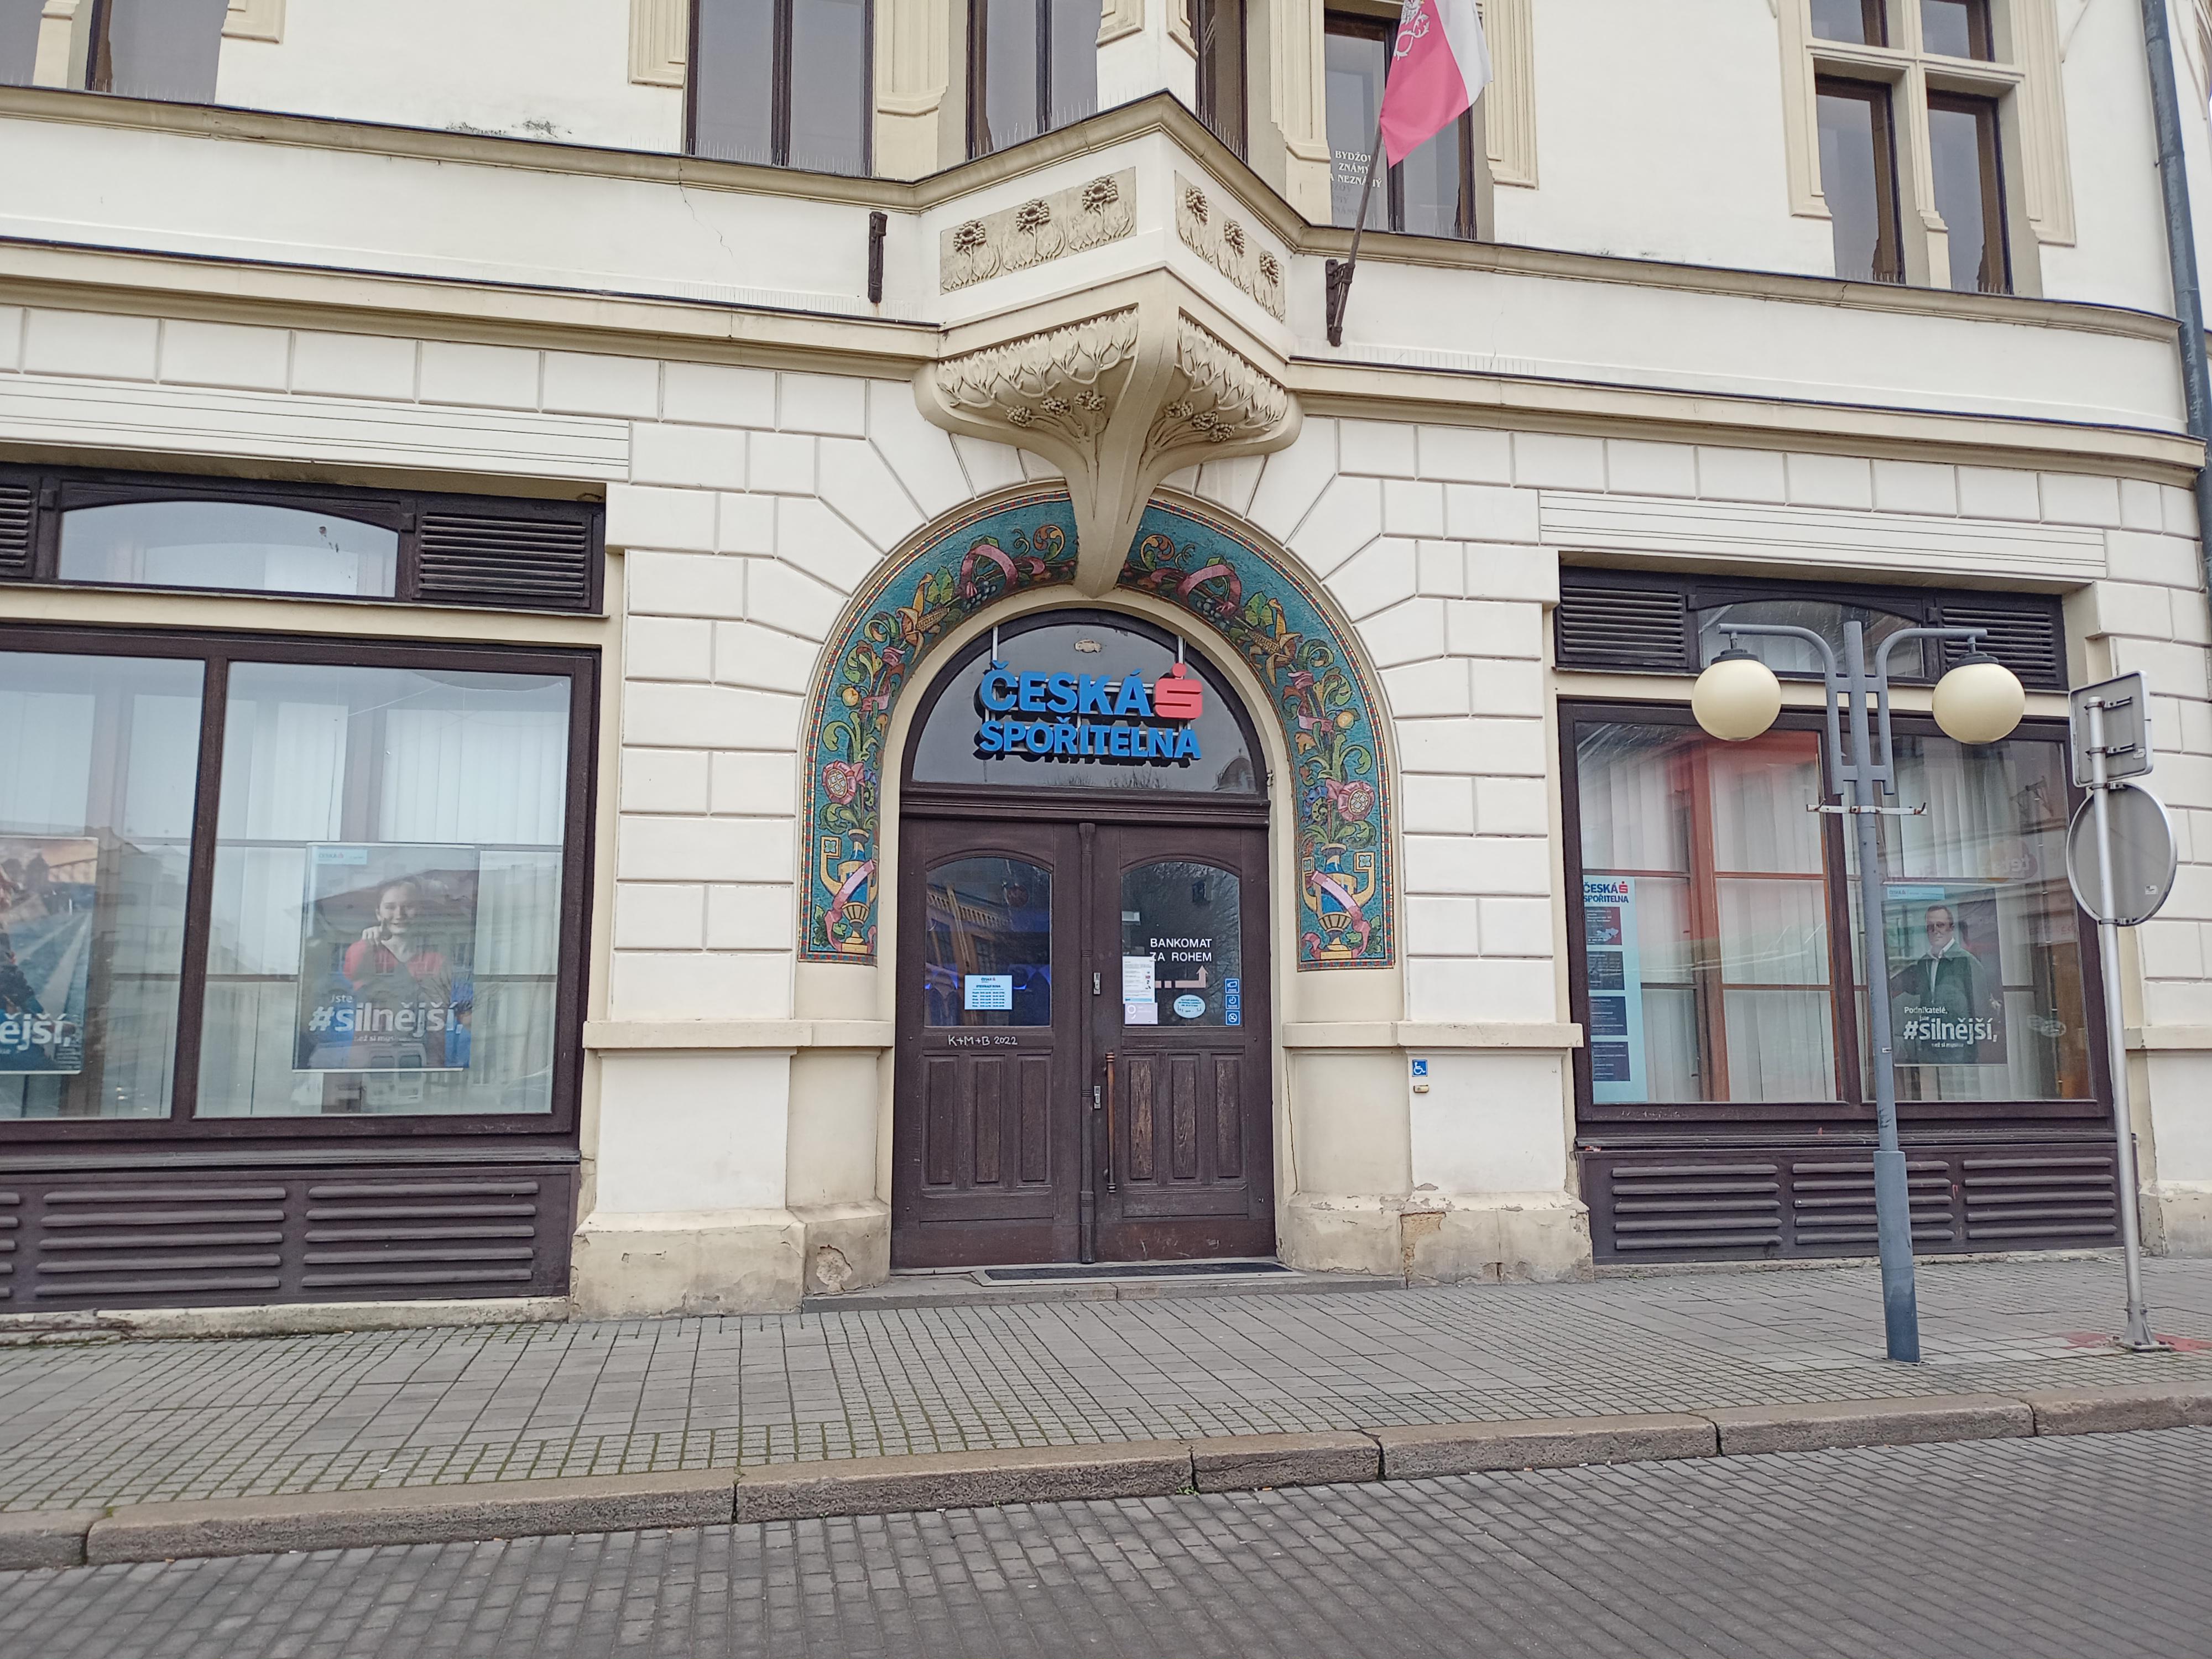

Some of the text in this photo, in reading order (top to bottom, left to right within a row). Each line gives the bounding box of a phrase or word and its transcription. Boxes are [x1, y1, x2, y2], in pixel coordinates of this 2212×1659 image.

[1338, 162, 1370, 174] ZNÁMÝ
[980, 660, 1154, 717] ČESKÁ
[978, 717, 1202, 760] SPOŘITELNA
[1583, 882, 1618, 894] ČESKÁ
[1583, 894, 1629, 903] SPOŘITELNA
[1150, 938, 1212, 948] BANKOMAT
[1149, 952, 1212, 962] ZA ROHEM
[309, 1001, 463, 1037] #silnější,
[1903, 1018, 1997, 1045] #silnější,
[994, 1036, 1018, 1045] 2022
